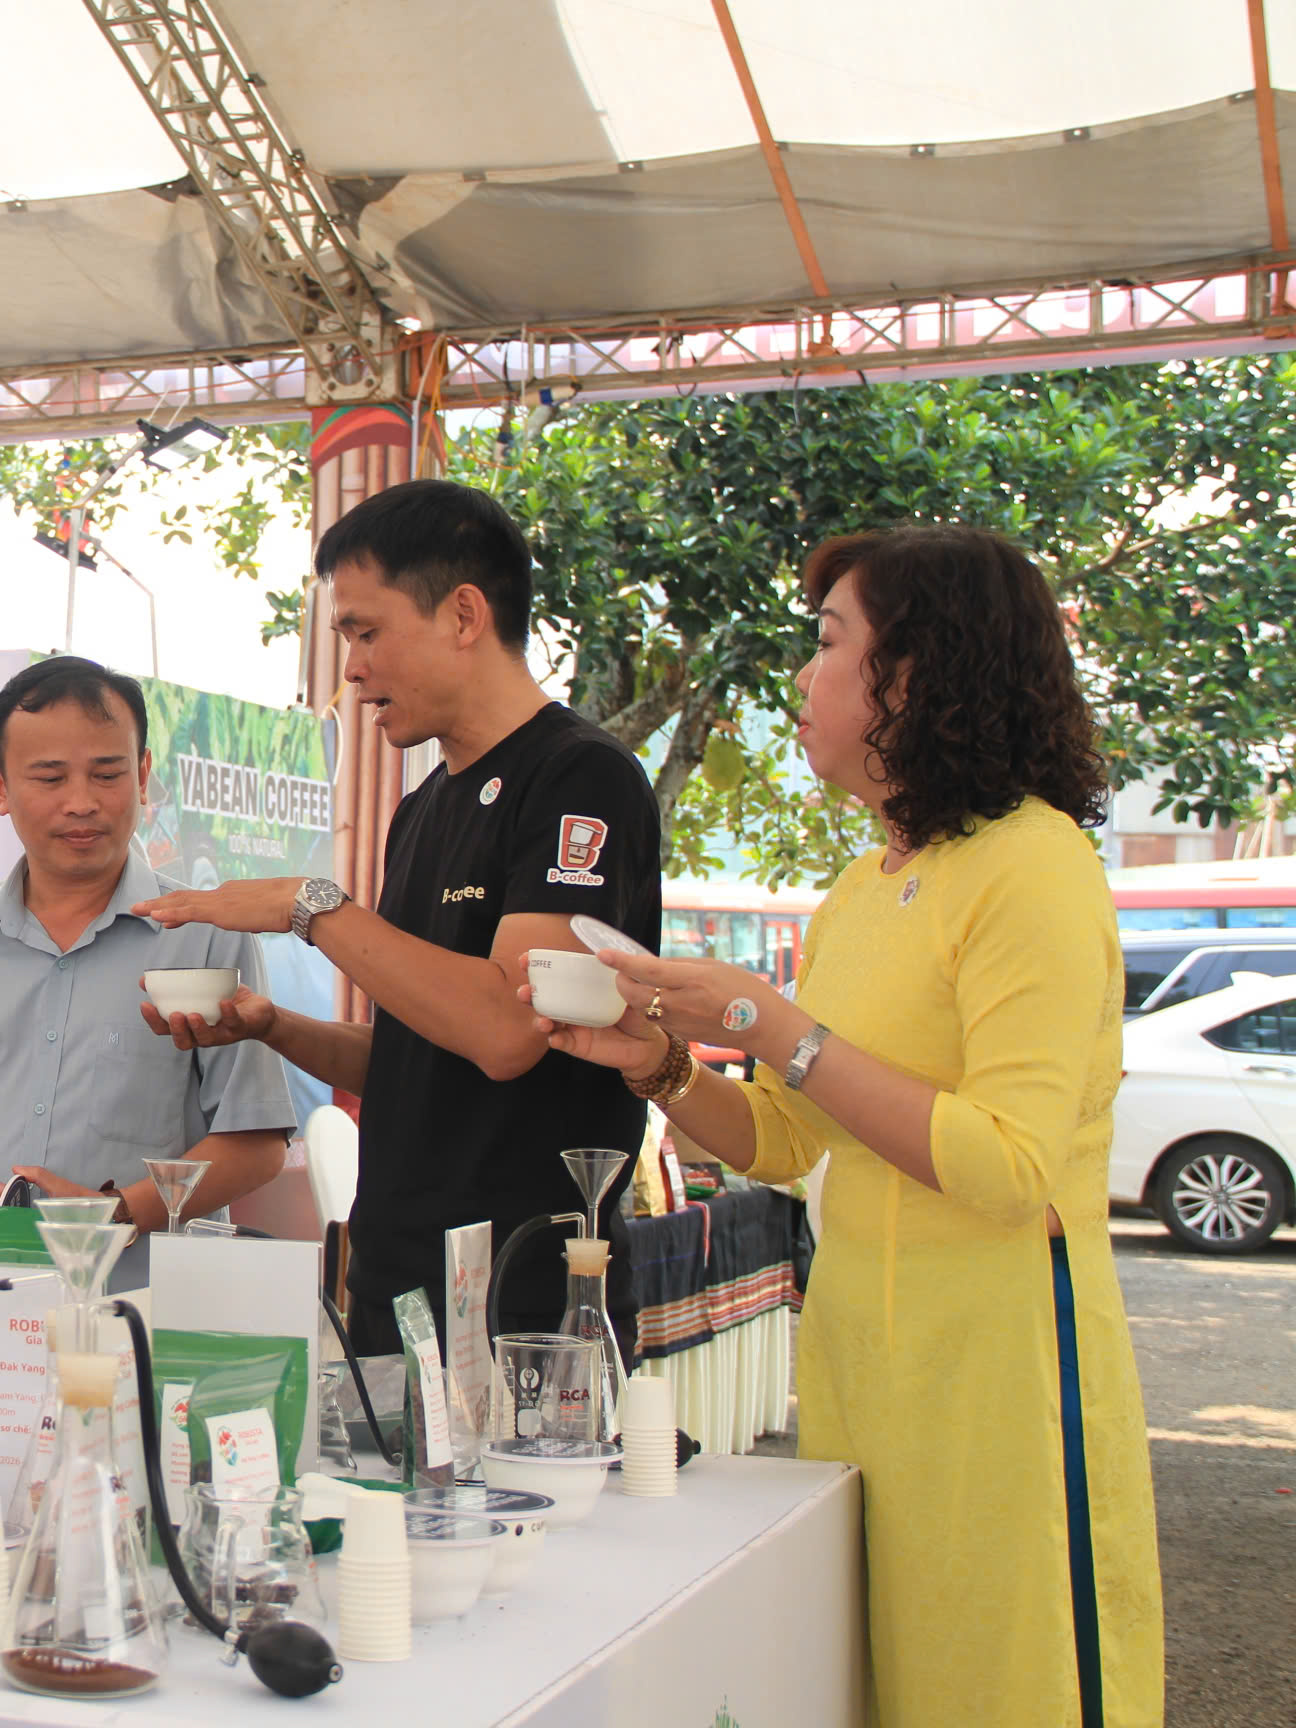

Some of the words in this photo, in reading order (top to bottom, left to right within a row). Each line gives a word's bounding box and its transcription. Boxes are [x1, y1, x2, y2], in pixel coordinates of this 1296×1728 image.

[178, 756, 259, 819] YABEAN
[263, 773, 330, 829] COFFEE
[549, 870, 602, 885] B-coffee
[25, 1335, 42, 1345] Gia
[21, 1363, 45, 1376] Yang
[560, 1388, 590, 1402] RCA
